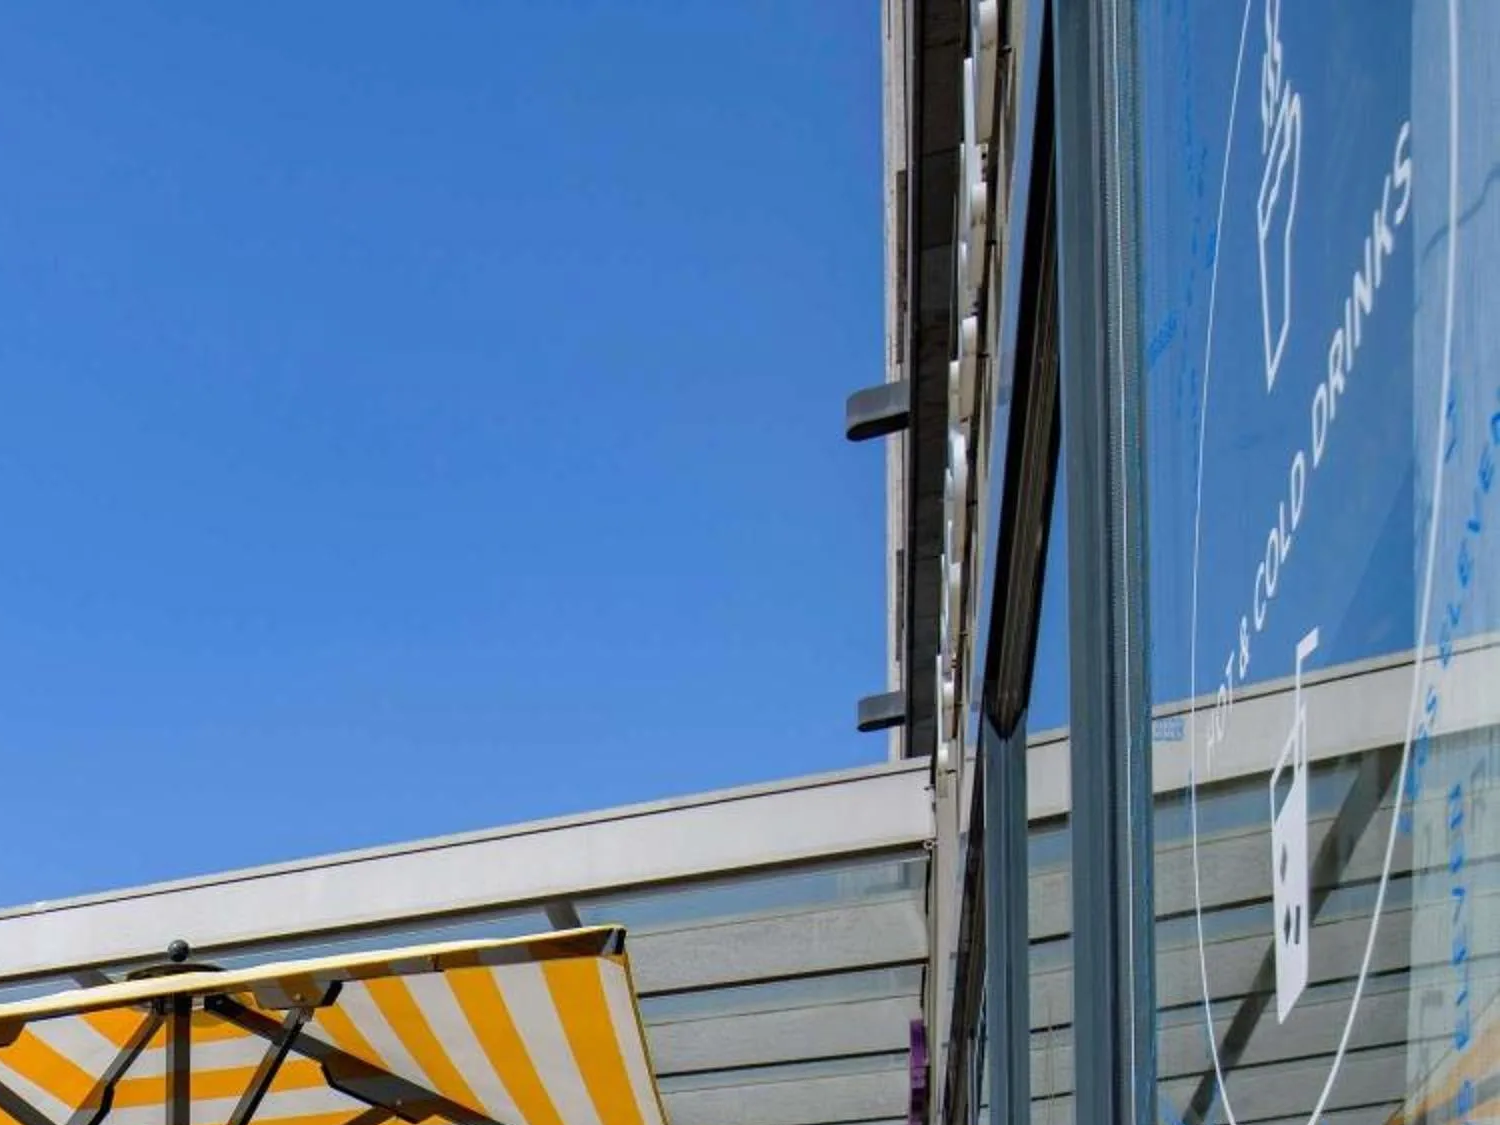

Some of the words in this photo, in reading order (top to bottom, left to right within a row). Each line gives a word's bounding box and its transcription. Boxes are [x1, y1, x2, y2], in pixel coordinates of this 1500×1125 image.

[1206, 651, 1236, 776] HOT
[1239, 616, 1250, 681] &
[1254, 451, 1306, 632] COLD
[1311, 121, 1412, 469] DRINKS
